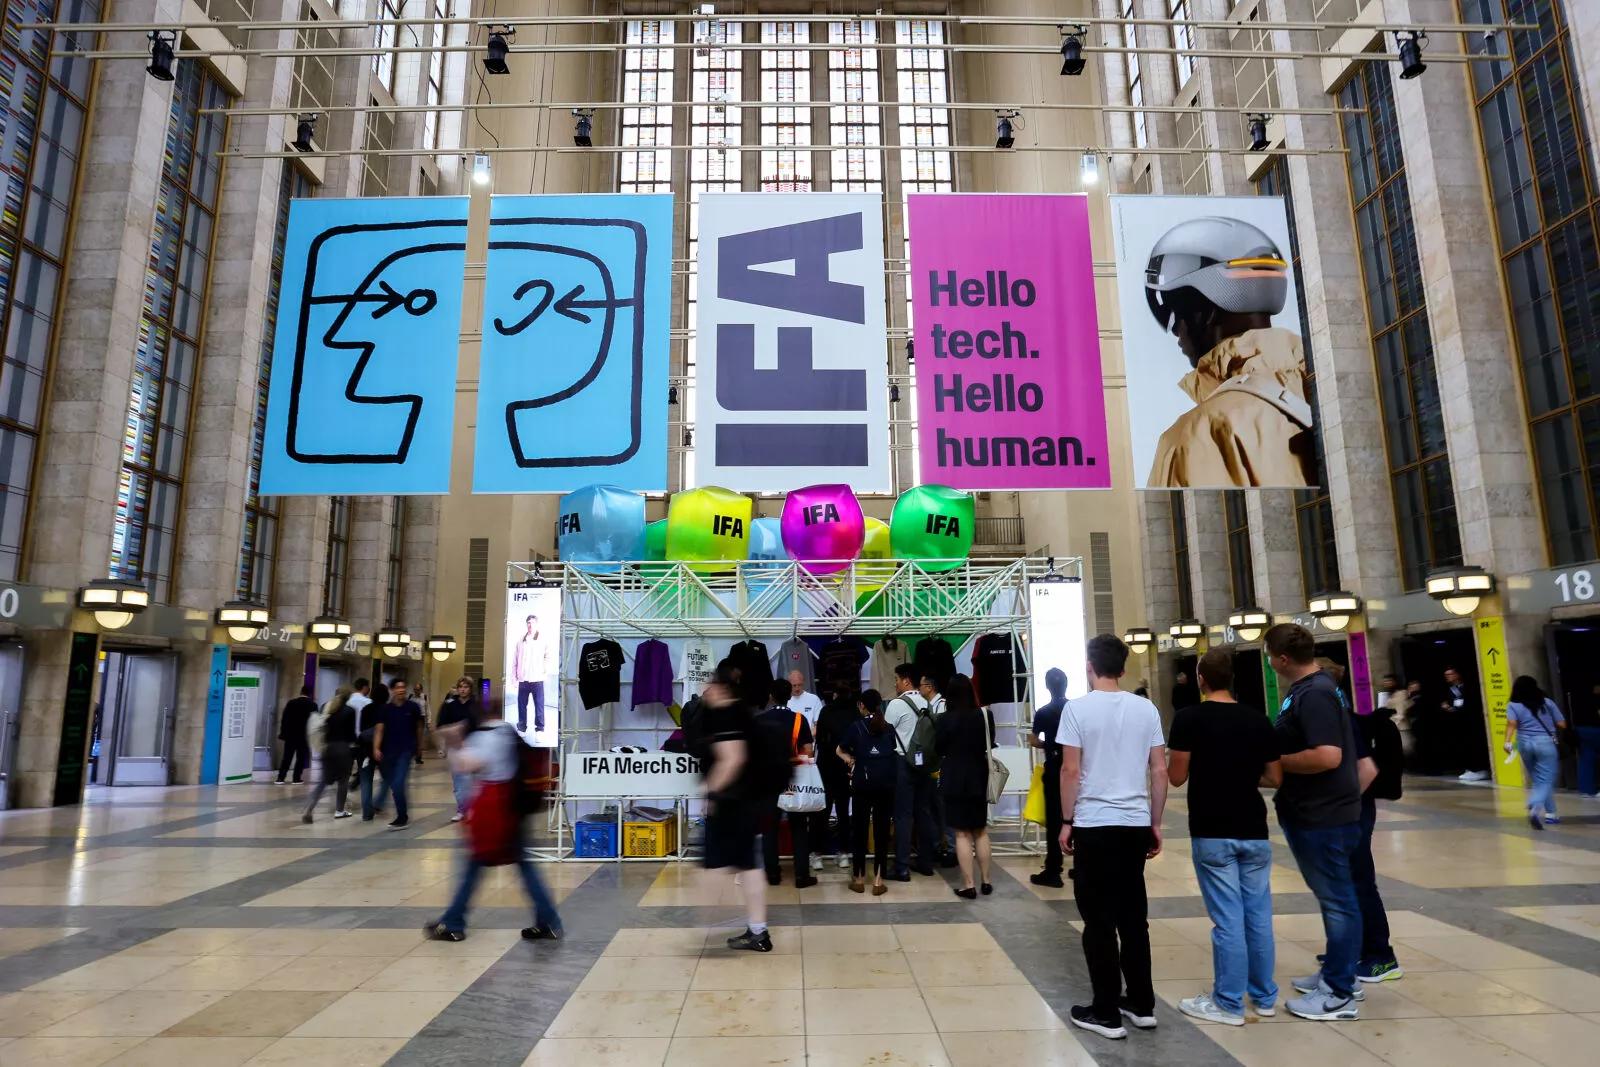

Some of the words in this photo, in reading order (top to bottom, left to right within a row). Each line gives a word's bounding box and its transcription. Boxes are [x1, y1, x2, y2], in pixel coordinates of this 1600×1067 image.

[930, 271, 1036, 307] Hello
[716, 212, 868, 466] IFA
[931, 322, 1039, 359] tech.
[935, 374, 1043, 412] Hello
[937, 428, 1096, 466] human.
[559, 513, 581, 536] IFA
[713, 515, 743, 538] IFA
[802, 504, 840, 526] IFA
[926, 514, 959, 538] IFA
[513, 593, 528, 602] IFA
[1035, 589, 1049, 597] IFA
[1554, 570, 1594, 602] 18
[257, 627, 270, 641] 20
[343, 636, 357, 653] 20
[1223, 626, 1235, 643] 18
[687, 653, 708, 661] FUTURE
[583, 757, 610, 774] IFA
[615, 757, 671, 774] Merch
